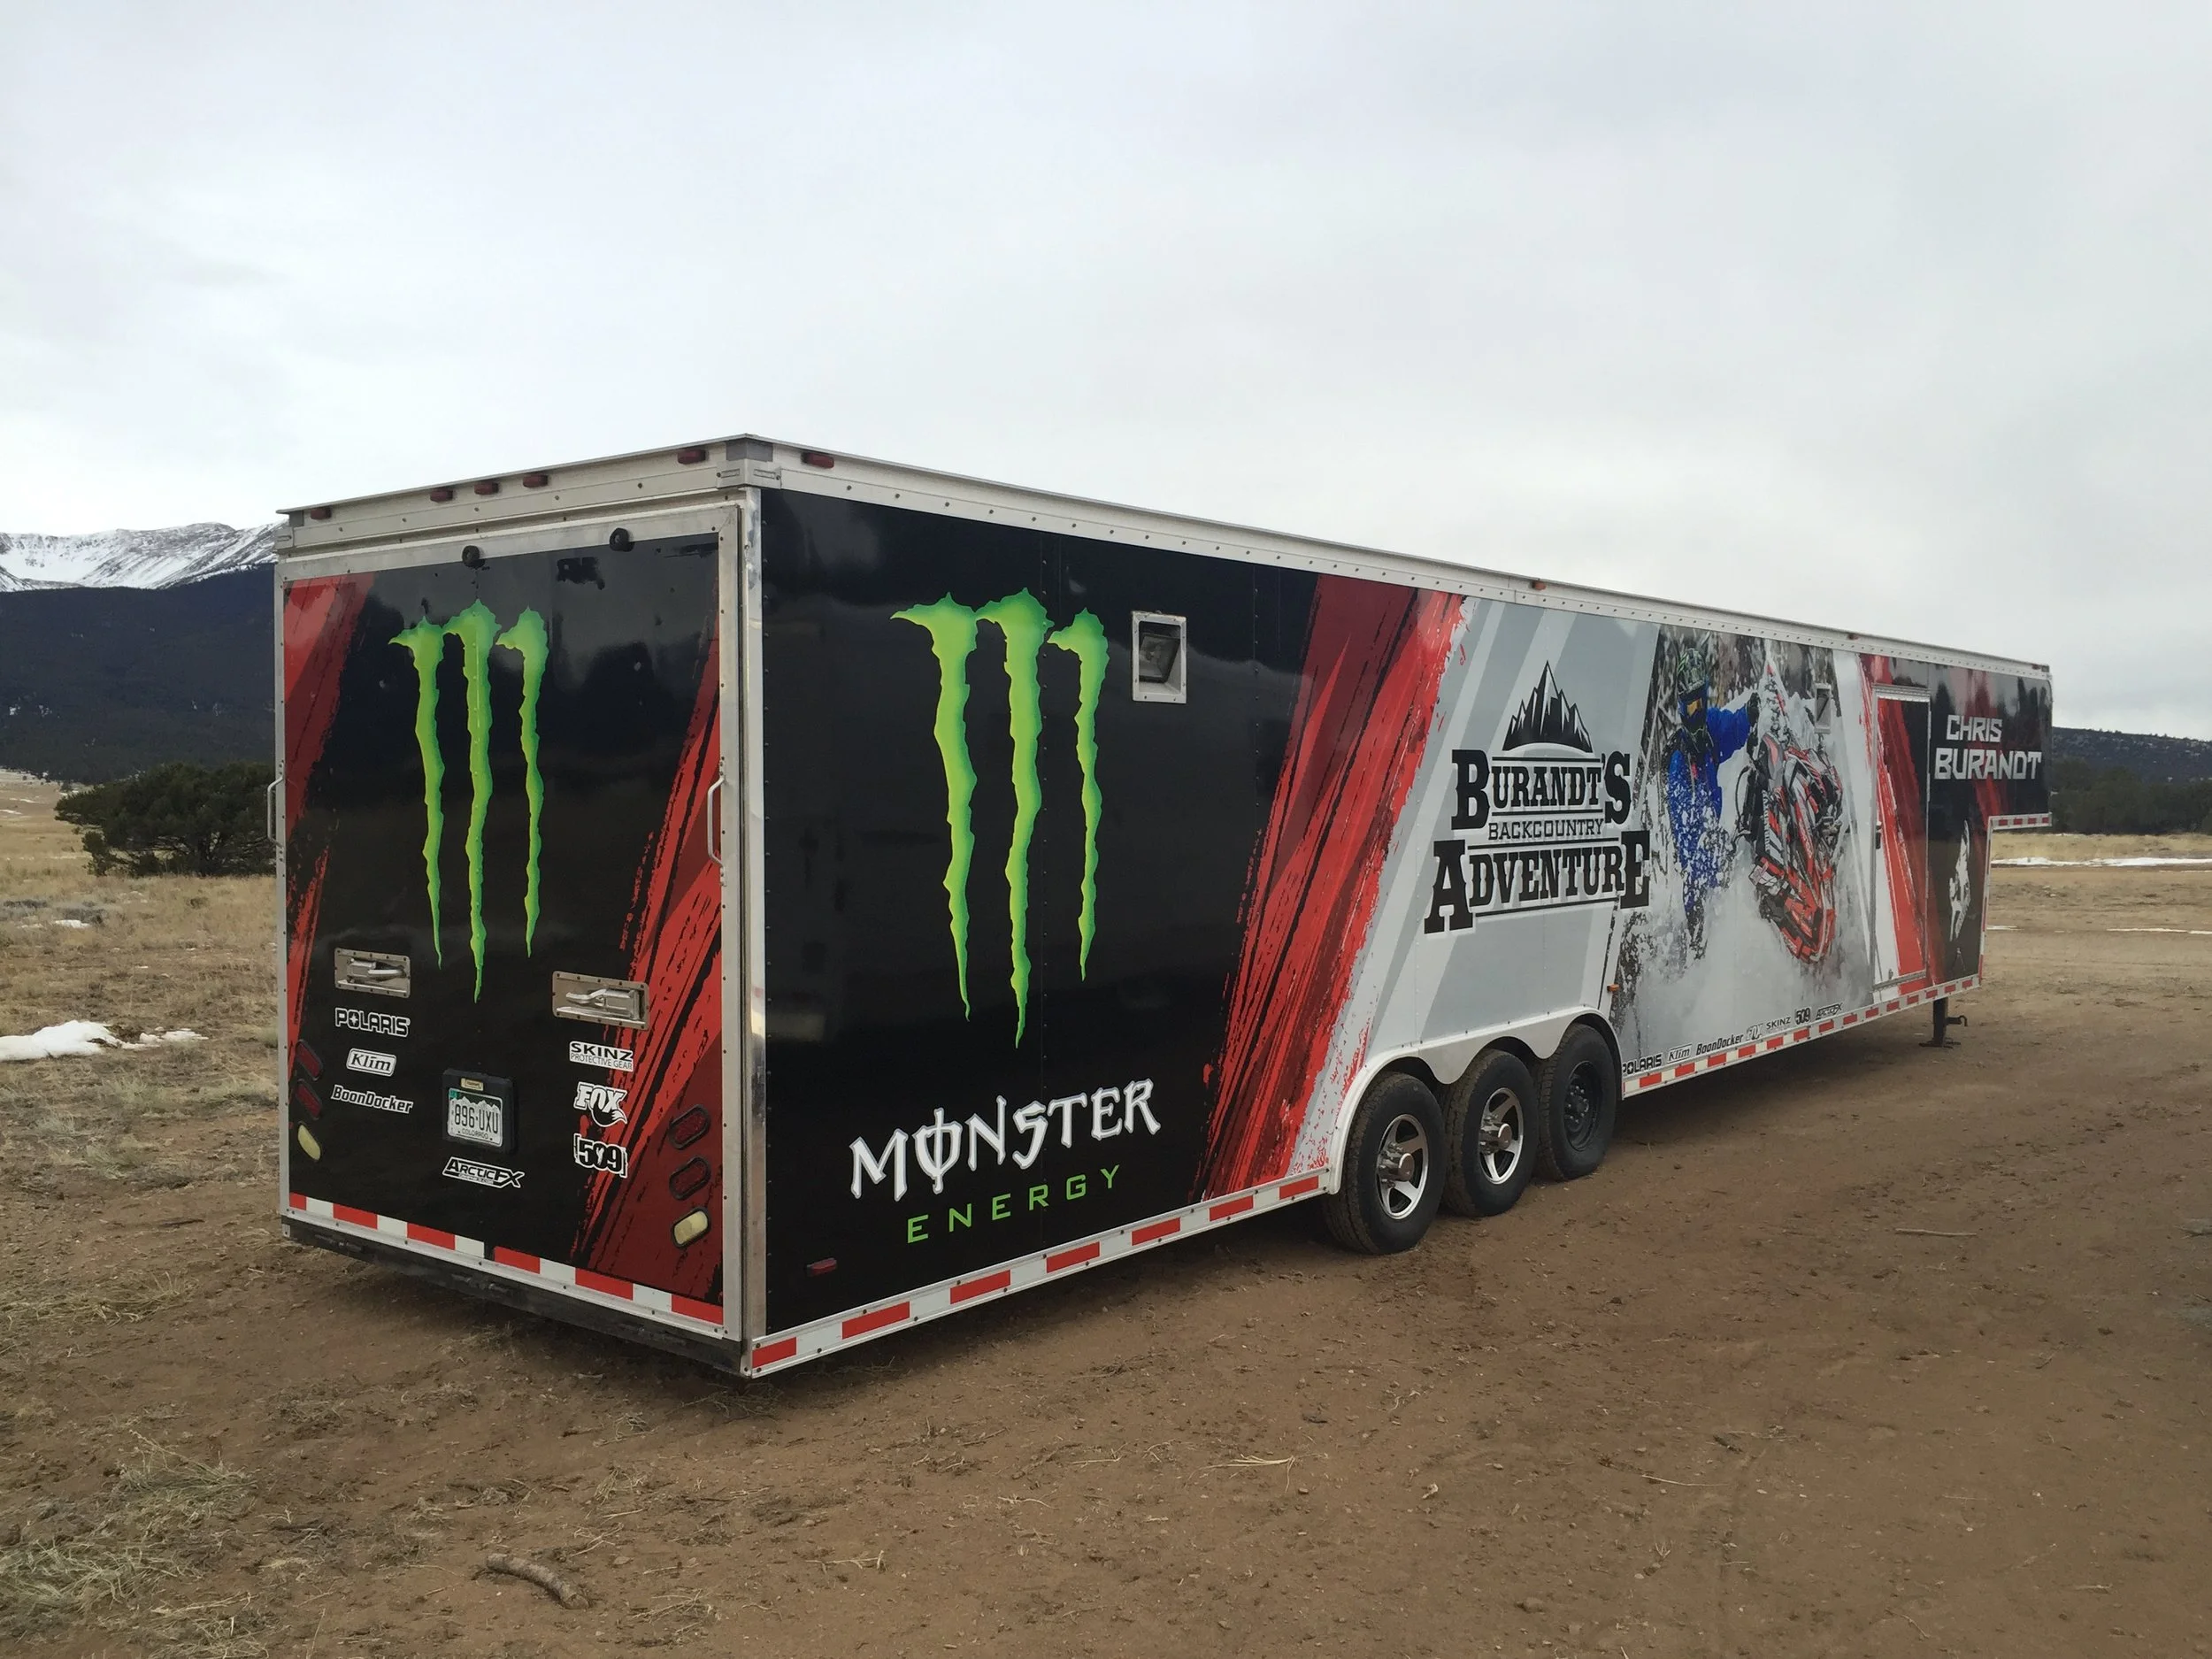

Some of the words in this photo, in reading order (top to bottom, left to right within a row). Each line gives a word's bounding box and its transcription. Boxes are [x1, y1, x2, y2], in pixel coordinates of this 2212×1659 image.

[1947, 714, 2003, 743] CHRIS
[1934, 748, 2042, 780] BURANDT
[1451, 749, 1632, 831] BURANDT'S
[1488, 818, 1604, 841] BACKCOUNTRY
[1424, 830, 1651, 934] ADVENTURE
[335, 1008, 411, 1037] POLARIS
[1695, 1033, 1744, 1056] BoonDocker
[1766, 1017, 1792, 1030] SKINZ
[570, 1053, 612, 1067] PROTECTIVE
[613, 1060, 633, 1071] GEAR
[571, 1042, 633, 1062] SKINZ
[331, 1085, 413, 1114] BoonDocker
[575, 1082, 627, 1114] FOX
[576, 1136, 625, 1175] 509
[849, 1078, 1161, 1202] MONSTER
[907, 1164, 1120, 1244] ENERGY
